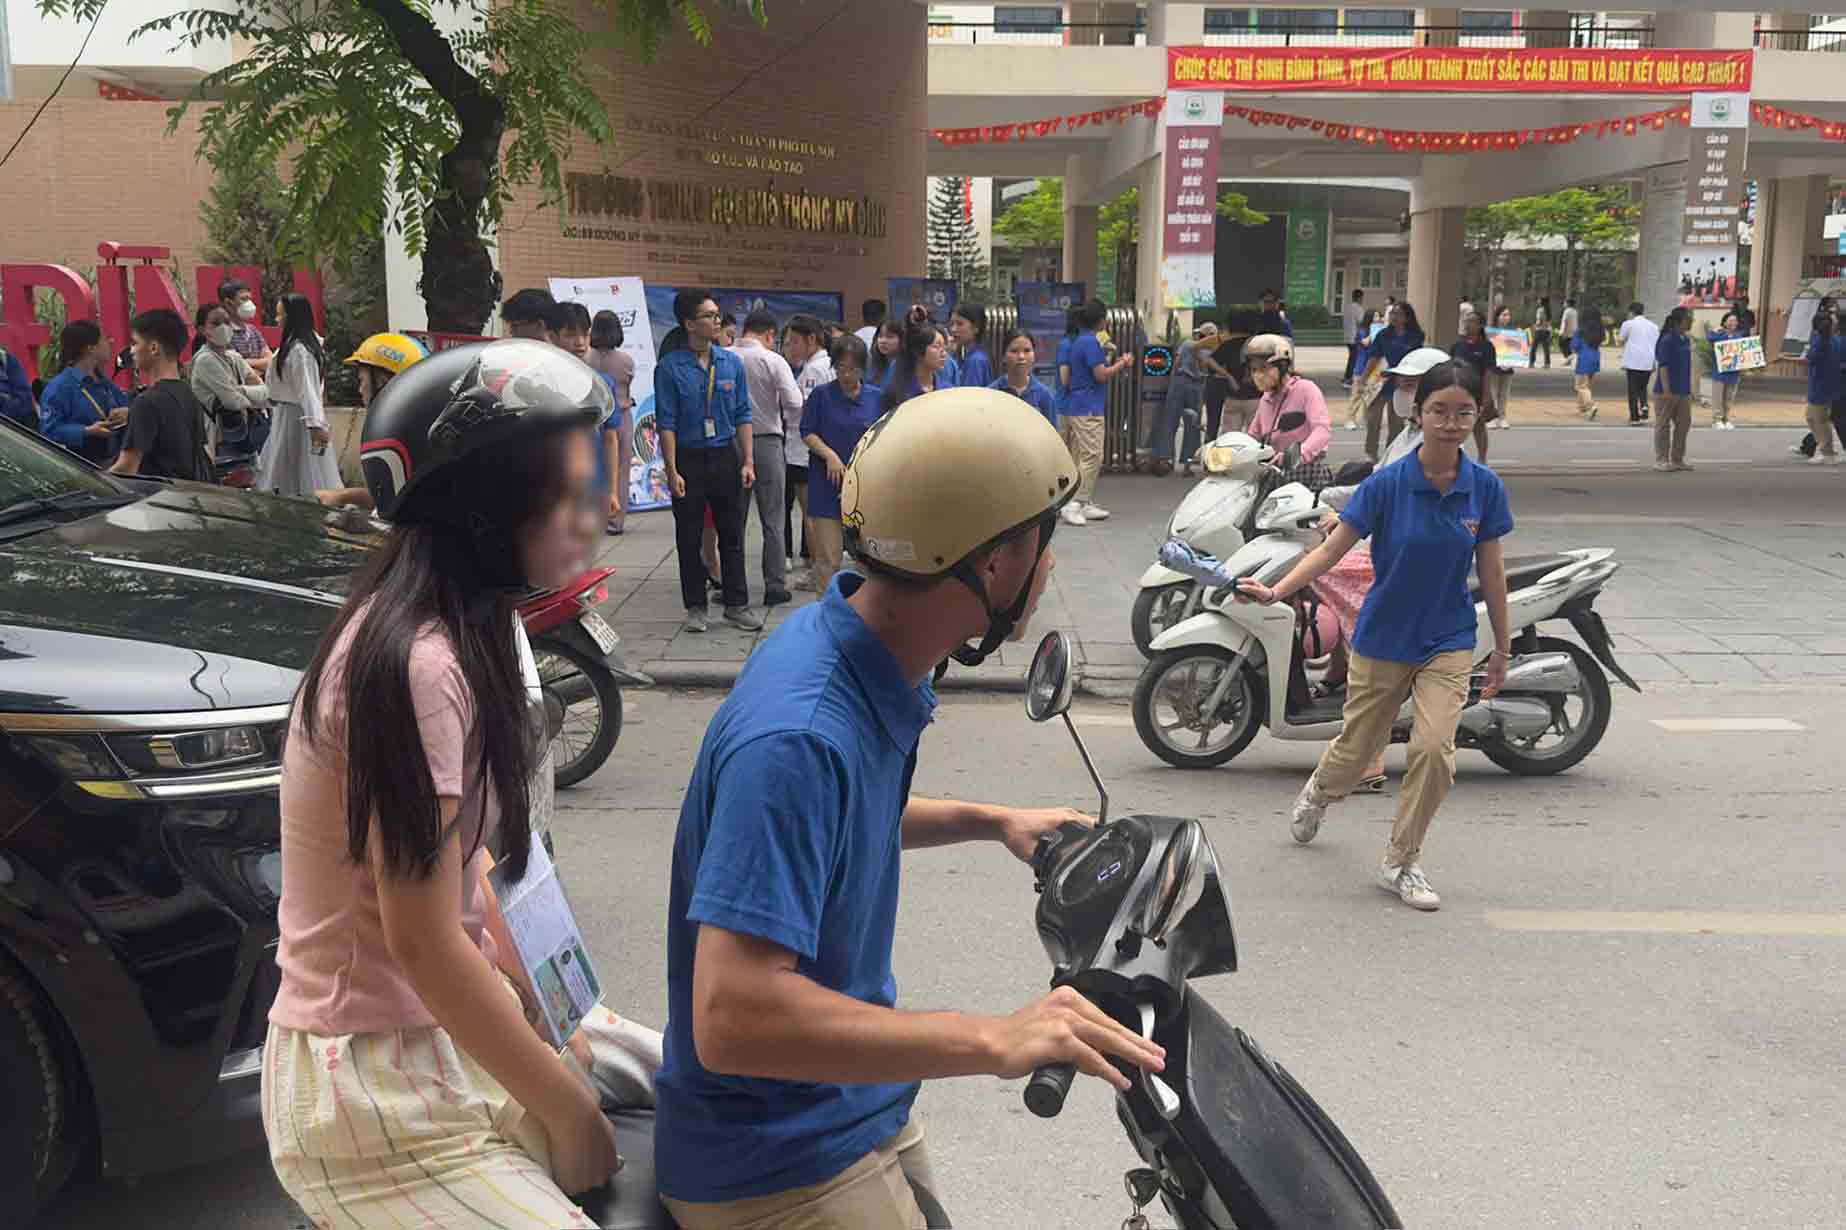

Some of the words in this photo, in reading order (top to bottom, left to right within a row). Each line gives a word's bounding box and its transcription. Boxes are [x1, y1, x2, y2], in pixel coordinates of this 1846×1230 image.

[1175, 54, 1205, 80] CHÚC
[1208, 53, 1232, 80] CÁC
[1235, 54, 1254, 80] THÍ
[1255, 58, 1284, 80] SINH
[1286, 55, 1314, 80] BÌNH
[1391, 54, 1423, 80] HOÀN
[1426, 54, 1463, 80] THÀNH
[1465, 53, 1494, 80] XUẤT
[1497, 51, 1521, 80] SẮC
[1523, 56, 1546, 80] CÁC
[1550, 56, 1568, 80] BÀI
[1571, 60, 1588, 80] THI
[1591, 56, 1606, 80] VÀ
[1633, 55, 1655, 83] KẾT
[1656, 54, 1680, 86] QUẢ
[1682, 61, 1704, 83] CAO
[1707, 56, 1737, 84] NHẤT
